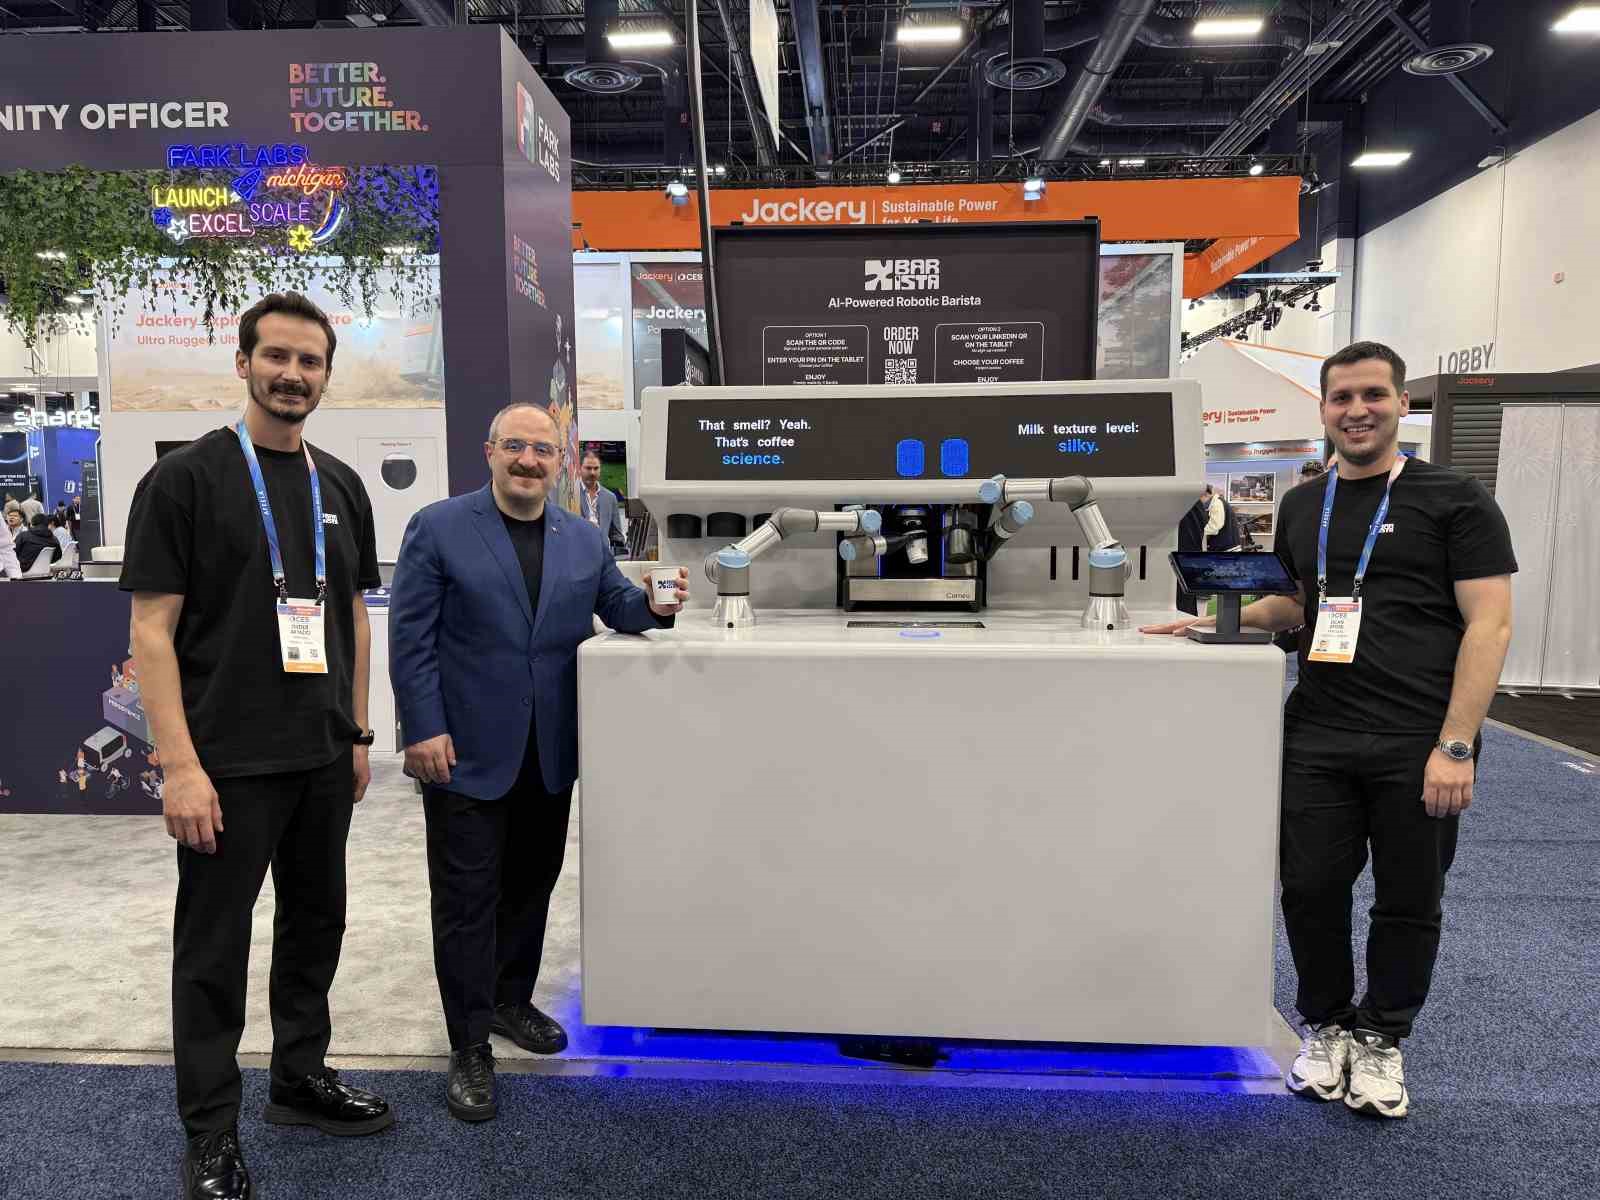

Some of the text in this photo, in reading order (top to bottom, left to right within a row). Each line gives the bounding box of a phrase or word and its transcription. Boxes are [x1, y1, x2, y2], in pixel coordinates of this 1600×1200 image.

[289, 62, 387, 83] BETTER.
[290, 86, 394, 108] FUTURE.
[79, 101, 229, 130] OFFICER
[290, 110, 429, 132] TOGETHER.
[538, 115, 560, 160] FARK
[168, 146, 305, 168] FARK LABS
[538, 142, 560, 184] LABS
[266, 163, 344, 195] michigan
[154, 186, 228, 208] LAUNCH
[881, 198, 998, 214] Sustainable Power
[250, 202, 312, 222] SCALE
[742, 198, 866, 224] Jackery
[189, 213, 251, 233] EXCEL
[686, 273, 703, 281] CES
[828, 295, 982, 308] AI-Powered Robotic Barista
[136, 315, 197, 329] Jackery
[646, 306, 706, 322] Jackery
[137, 335, 165, 345] Ultra
[169, 335, 216, 347] Rugge
[883, 327, 919, 341] ORDER
[888, 341, 914, 354] NOW
[1438, 342, 1495, 375] LOBBY
[698, 419, 811, 431] That smell? Yeah.
[1018, 421, 1139, 435] Milk texture level:
[714, 436, 795, 447] That's coffee
[1058, 439, 1099, 454] silky.
[722, 452, 784, 465] science.
